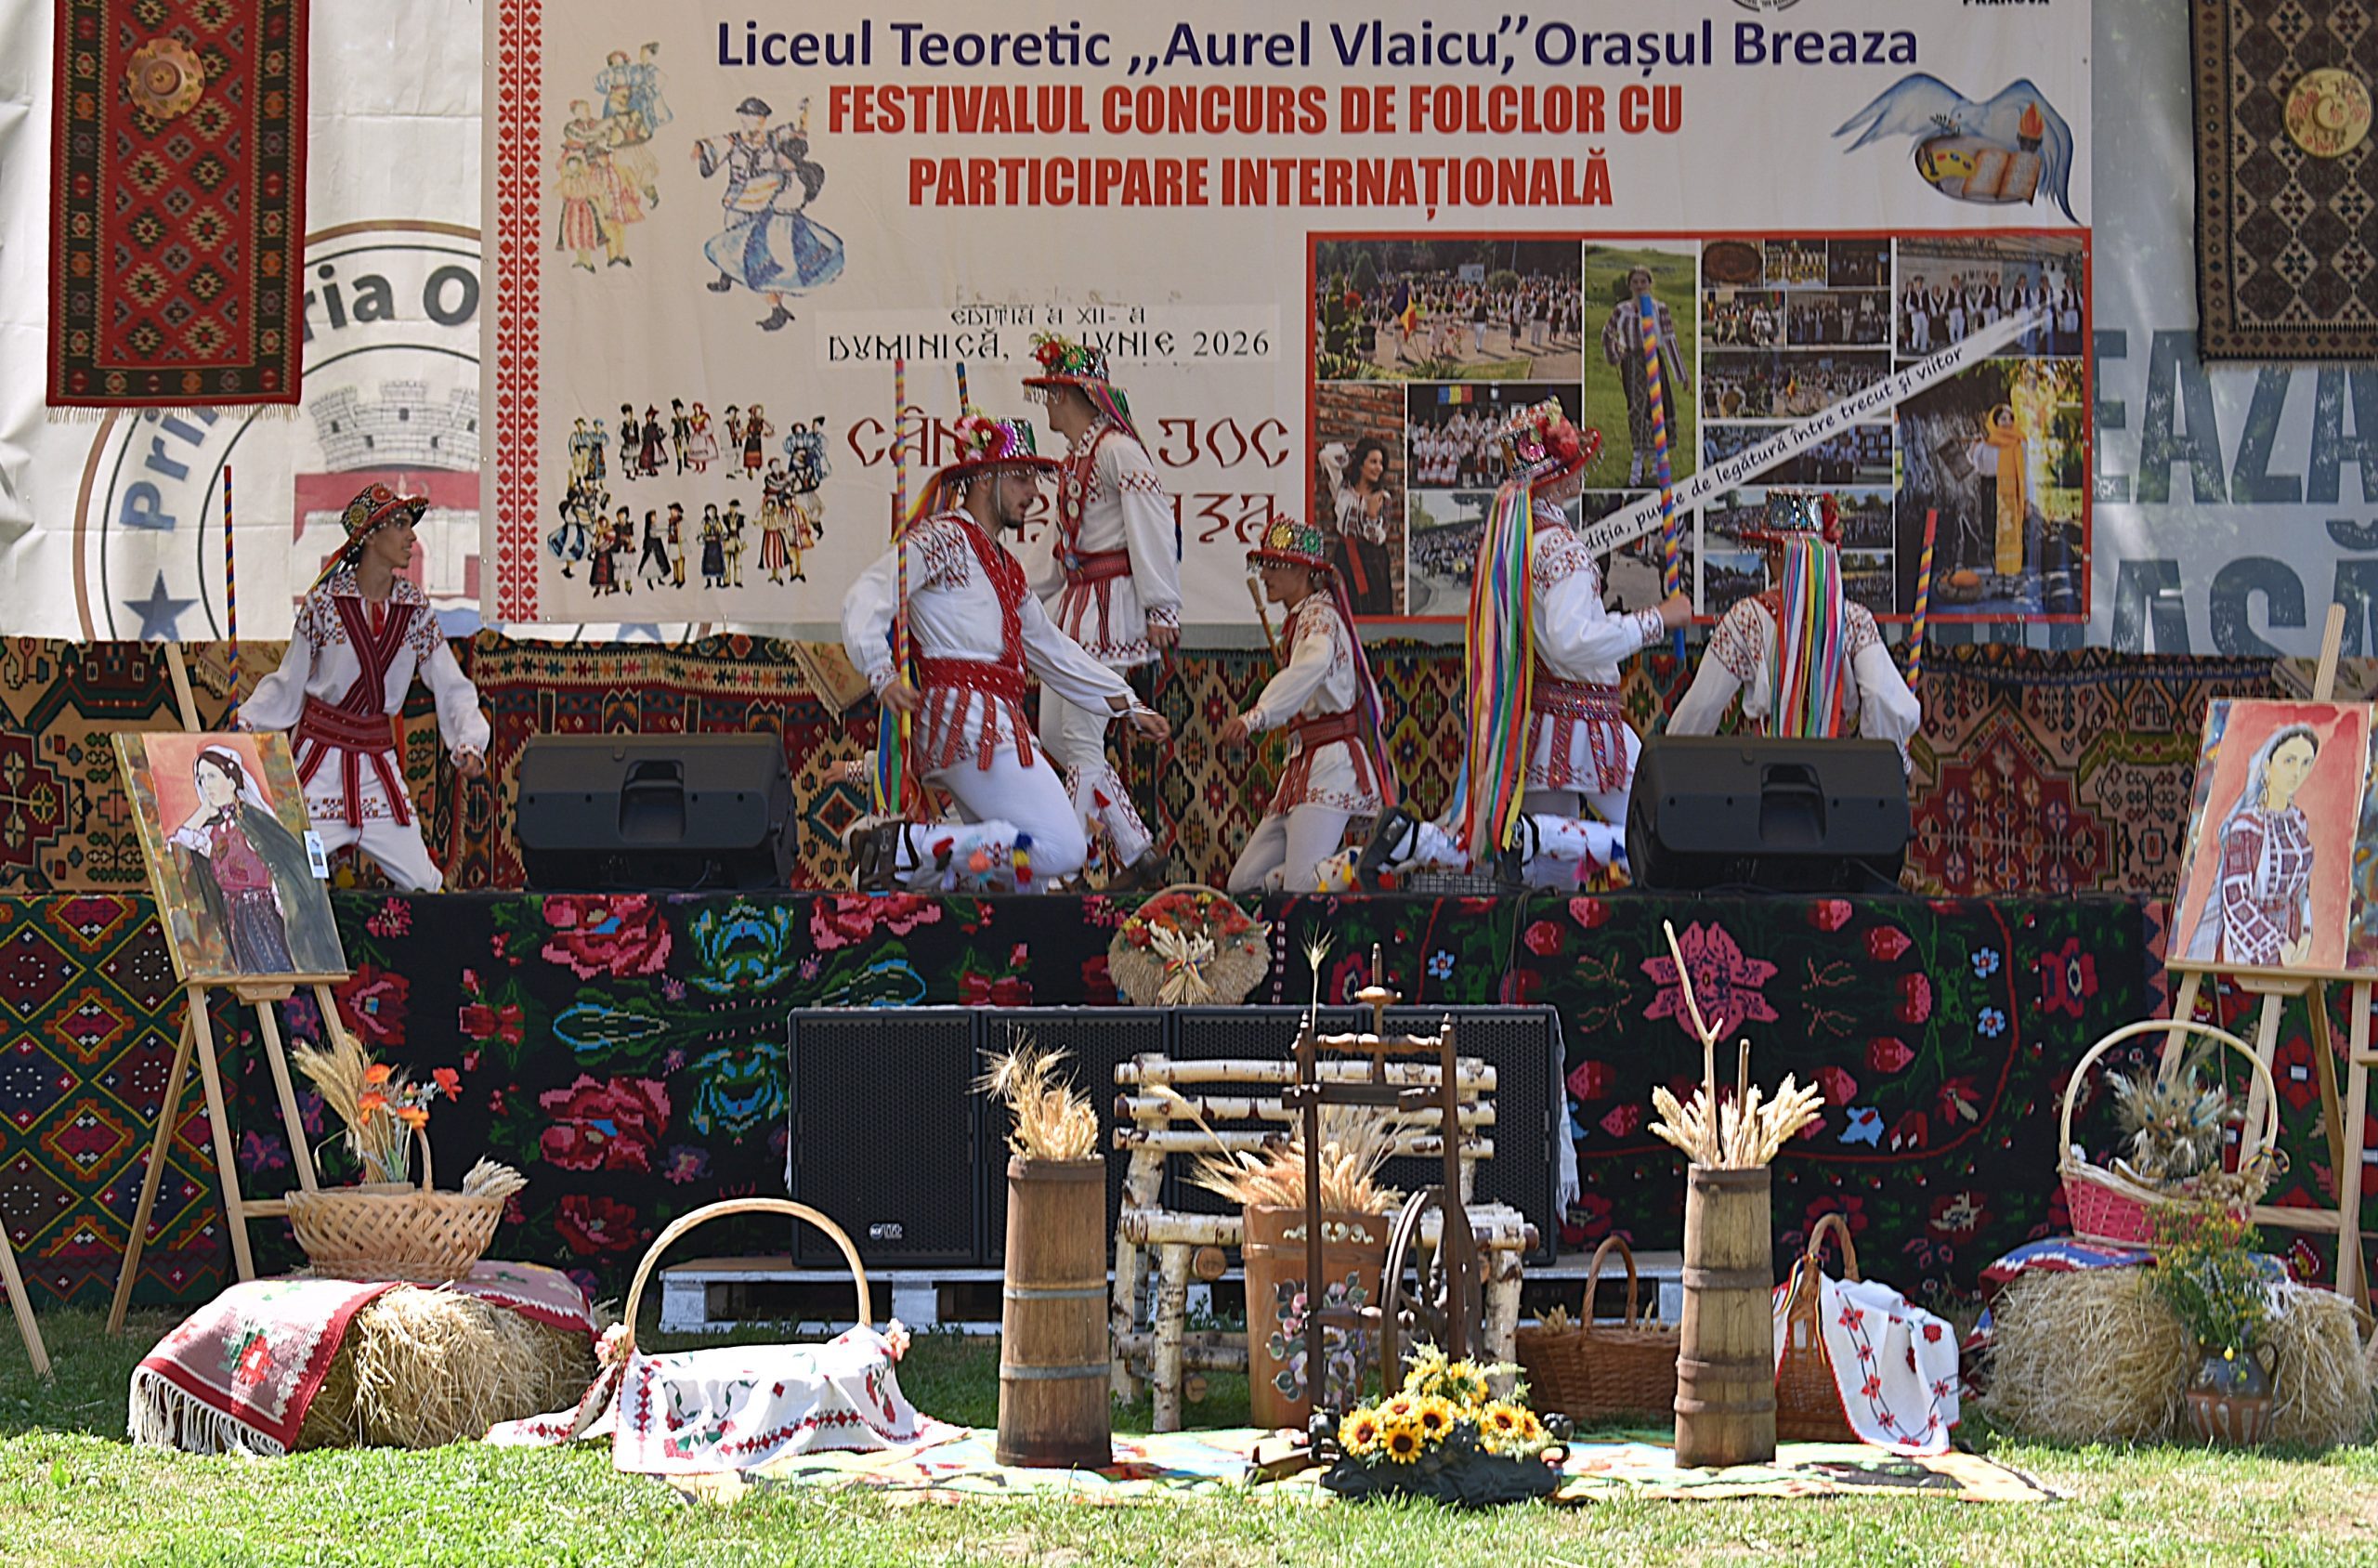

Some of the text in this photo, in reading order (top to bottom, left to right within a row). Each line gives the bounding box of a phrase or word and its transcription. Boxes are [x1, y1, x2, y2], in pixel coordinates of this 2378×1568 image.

[719, 20, 871, 67] Liceul
[890, 20, 1110, 67] Teoretic
[1735, 20, 1917, 67] Breaza
[830, 85, 1682, 135] FESTIVALUL CONCURS DE FOLCLOR CU
[909, 149, 1613, 219] PARTICIPARE INTERNAȚIONALĂ
[1193, 331, 1270, 357] 2026
[847, 405, 960, 467] CÂN
[1691, 477, 1712, 498] de
[1840, 383, 1894, 419] trecut
[1916, 347, 1963, 380] viitor
